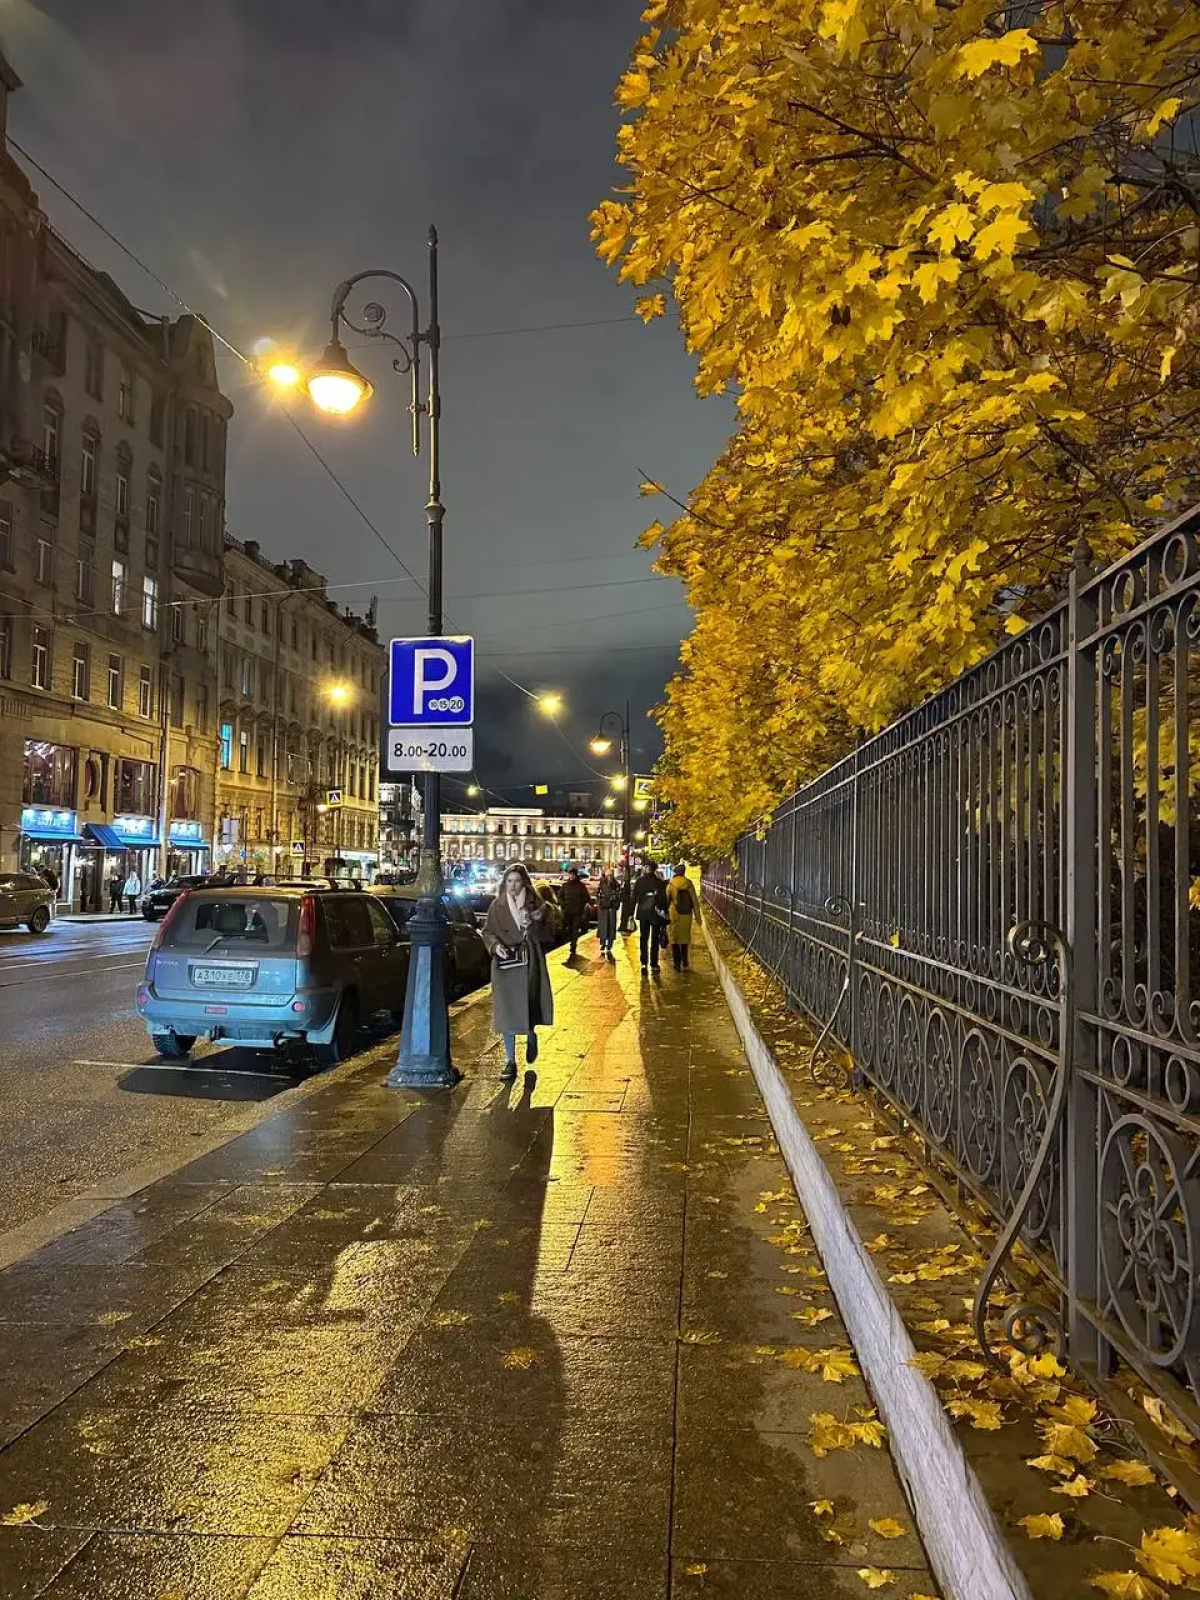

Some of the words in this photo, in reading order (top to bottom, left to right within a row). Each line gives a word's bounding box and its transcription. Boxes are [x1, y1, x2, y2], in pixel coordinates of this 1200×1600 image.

[414, 648, 458, 715] P
[450, 699, 463, 710] 20
[394, 742, 467, 757] 8.00-20.00
